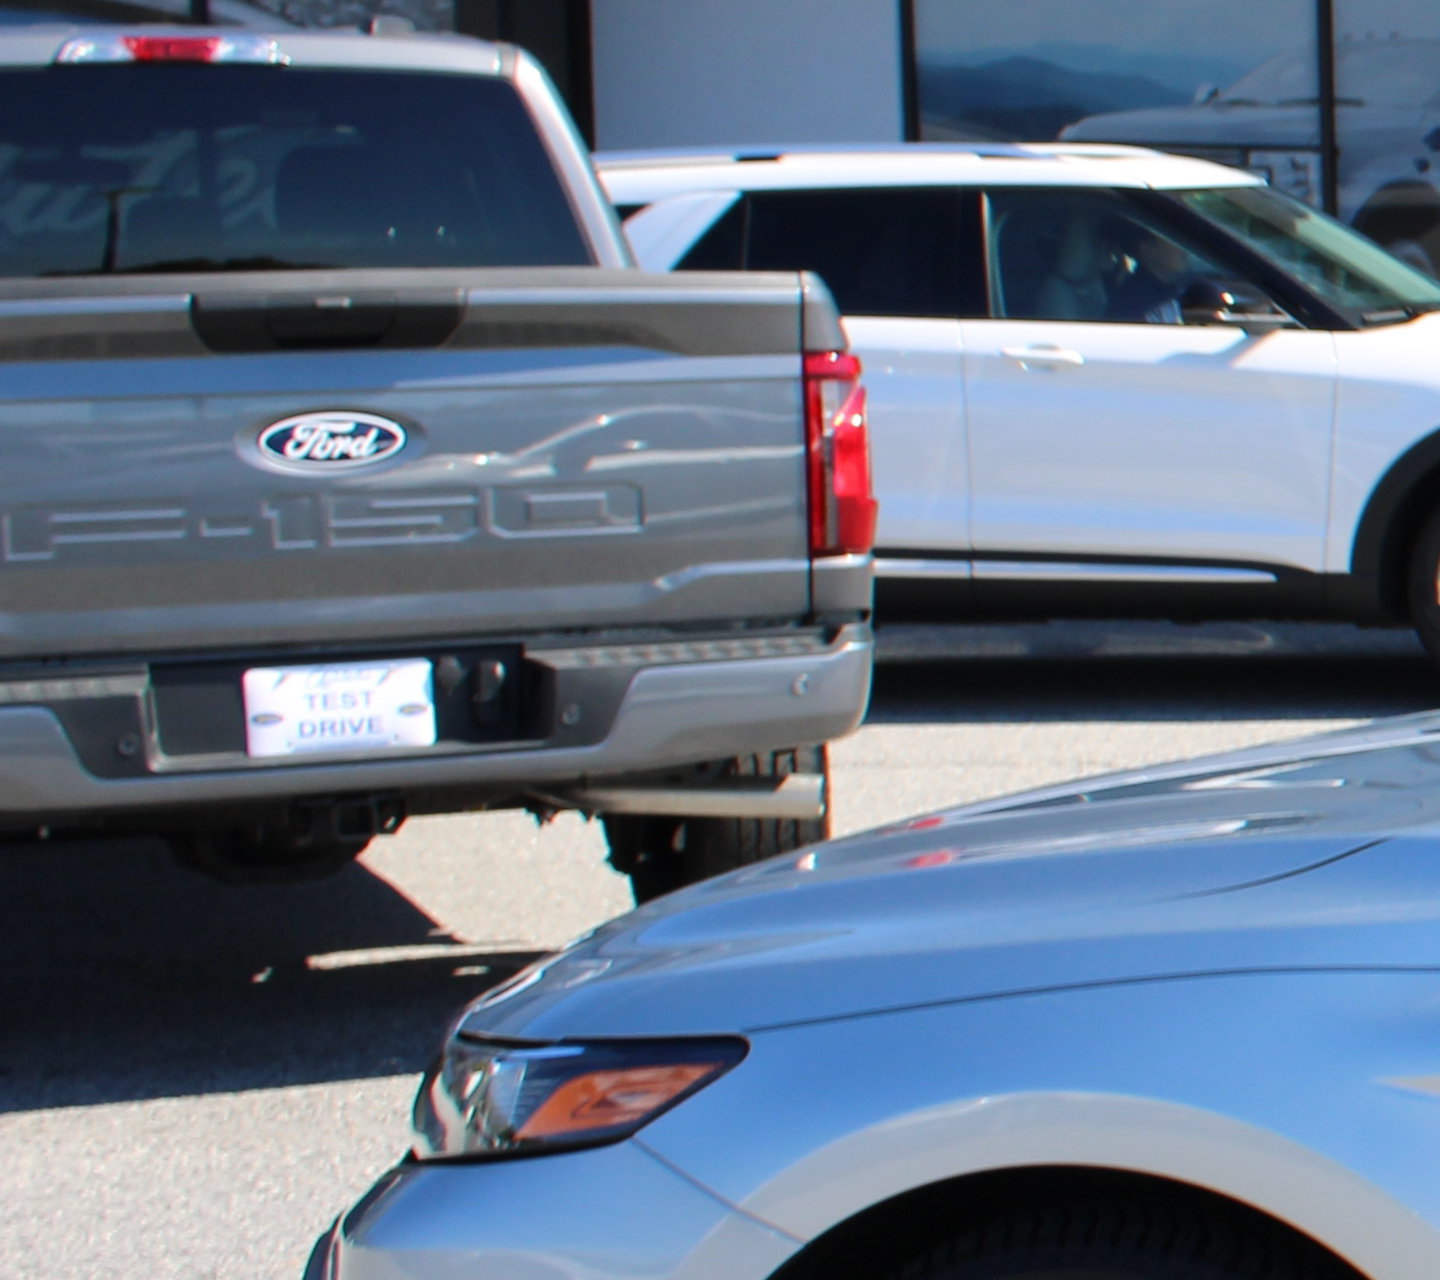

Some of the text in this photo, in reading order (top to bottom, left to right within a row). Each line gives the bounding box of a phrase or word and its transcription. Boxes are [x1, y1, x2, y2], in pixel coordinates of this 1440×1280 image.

[283, 421, 382, 460] Ford
[2, 480, 646, 562] F-150
[303, 689, 374, 712] TEST
[297, 714, 384, 739] DRIVE
